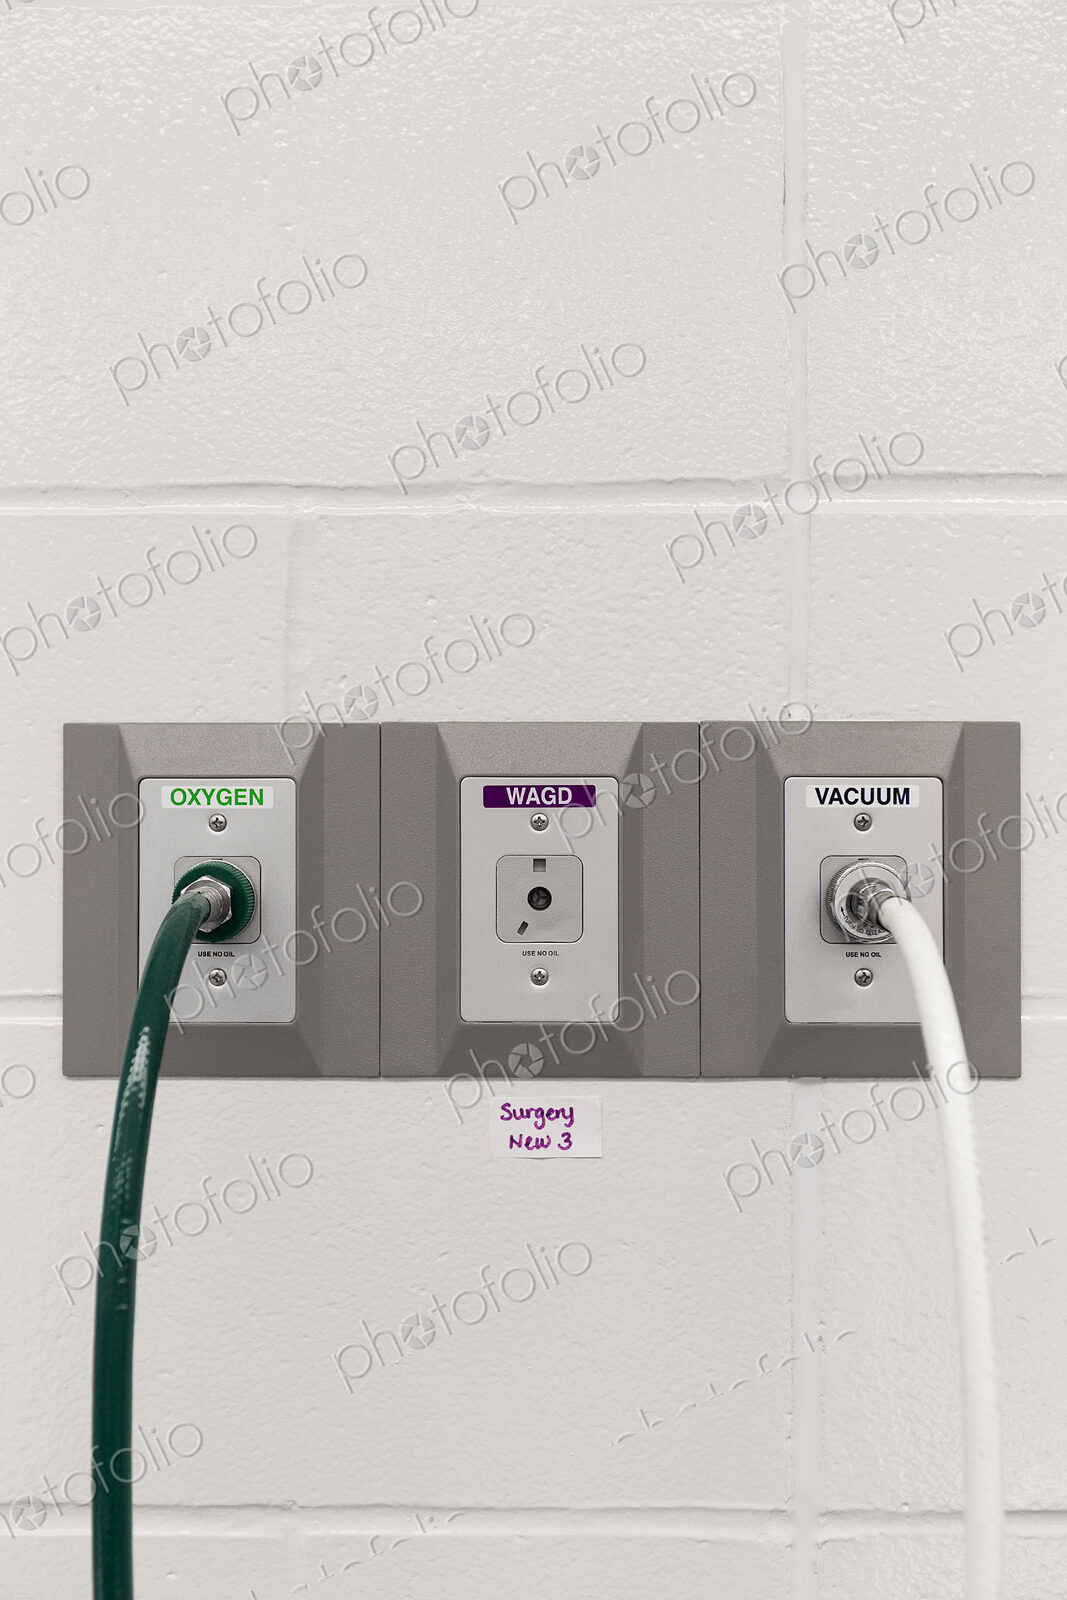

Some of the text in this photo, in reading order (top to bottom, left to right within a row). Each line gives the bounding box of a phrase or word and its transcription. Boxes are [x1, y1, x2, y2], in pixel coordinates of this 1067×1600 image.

[170, 787, 264, 806] OXYGEN
[506, 786, 573, 806] WAGD
[814, 787, 910, 806] VACUUM
[500, 1102, 575, 1131] Surgery
[509, 1131, 573, 1151] New 3
